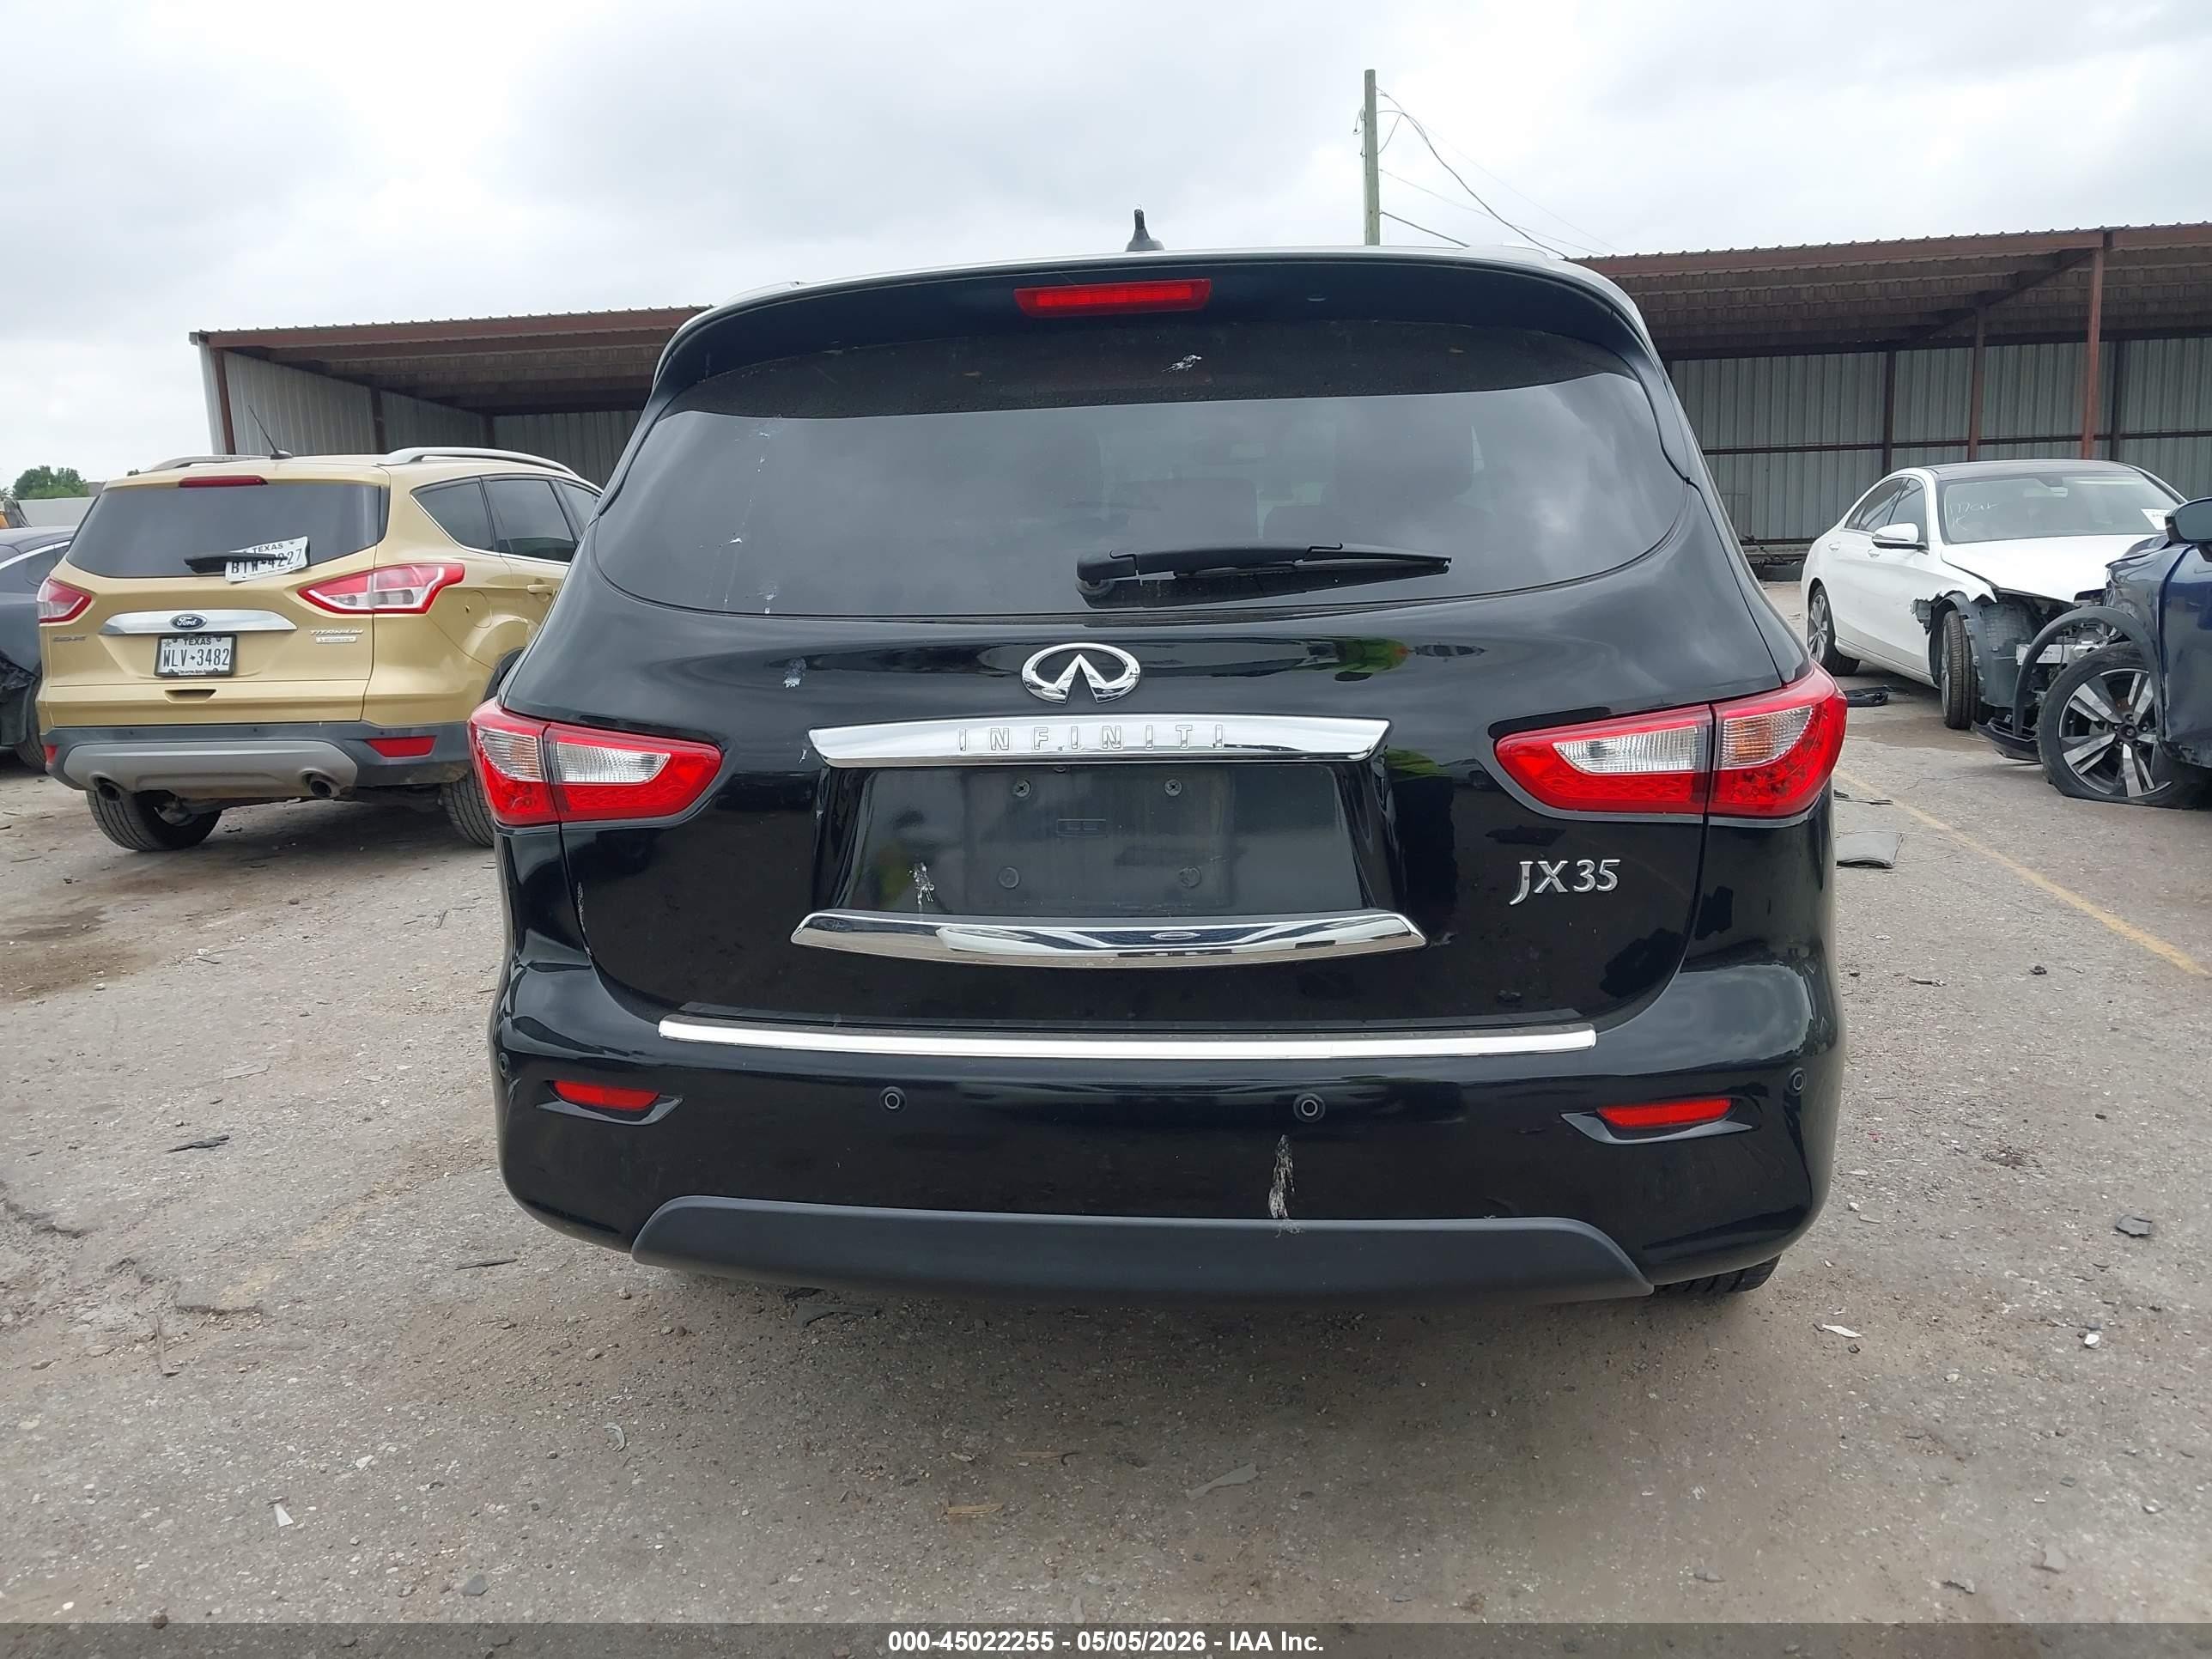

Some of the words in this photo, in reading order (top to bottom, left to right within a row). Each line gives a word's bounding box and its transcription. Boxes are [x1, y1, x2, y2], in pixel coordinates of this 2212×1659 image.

[252, 543, 283, 554] TEXAS
[177, 617, 197, 626] Ford
[957, 725, 1224, 751] INFINITI
[1509, 859, 1621, 906] JX35
